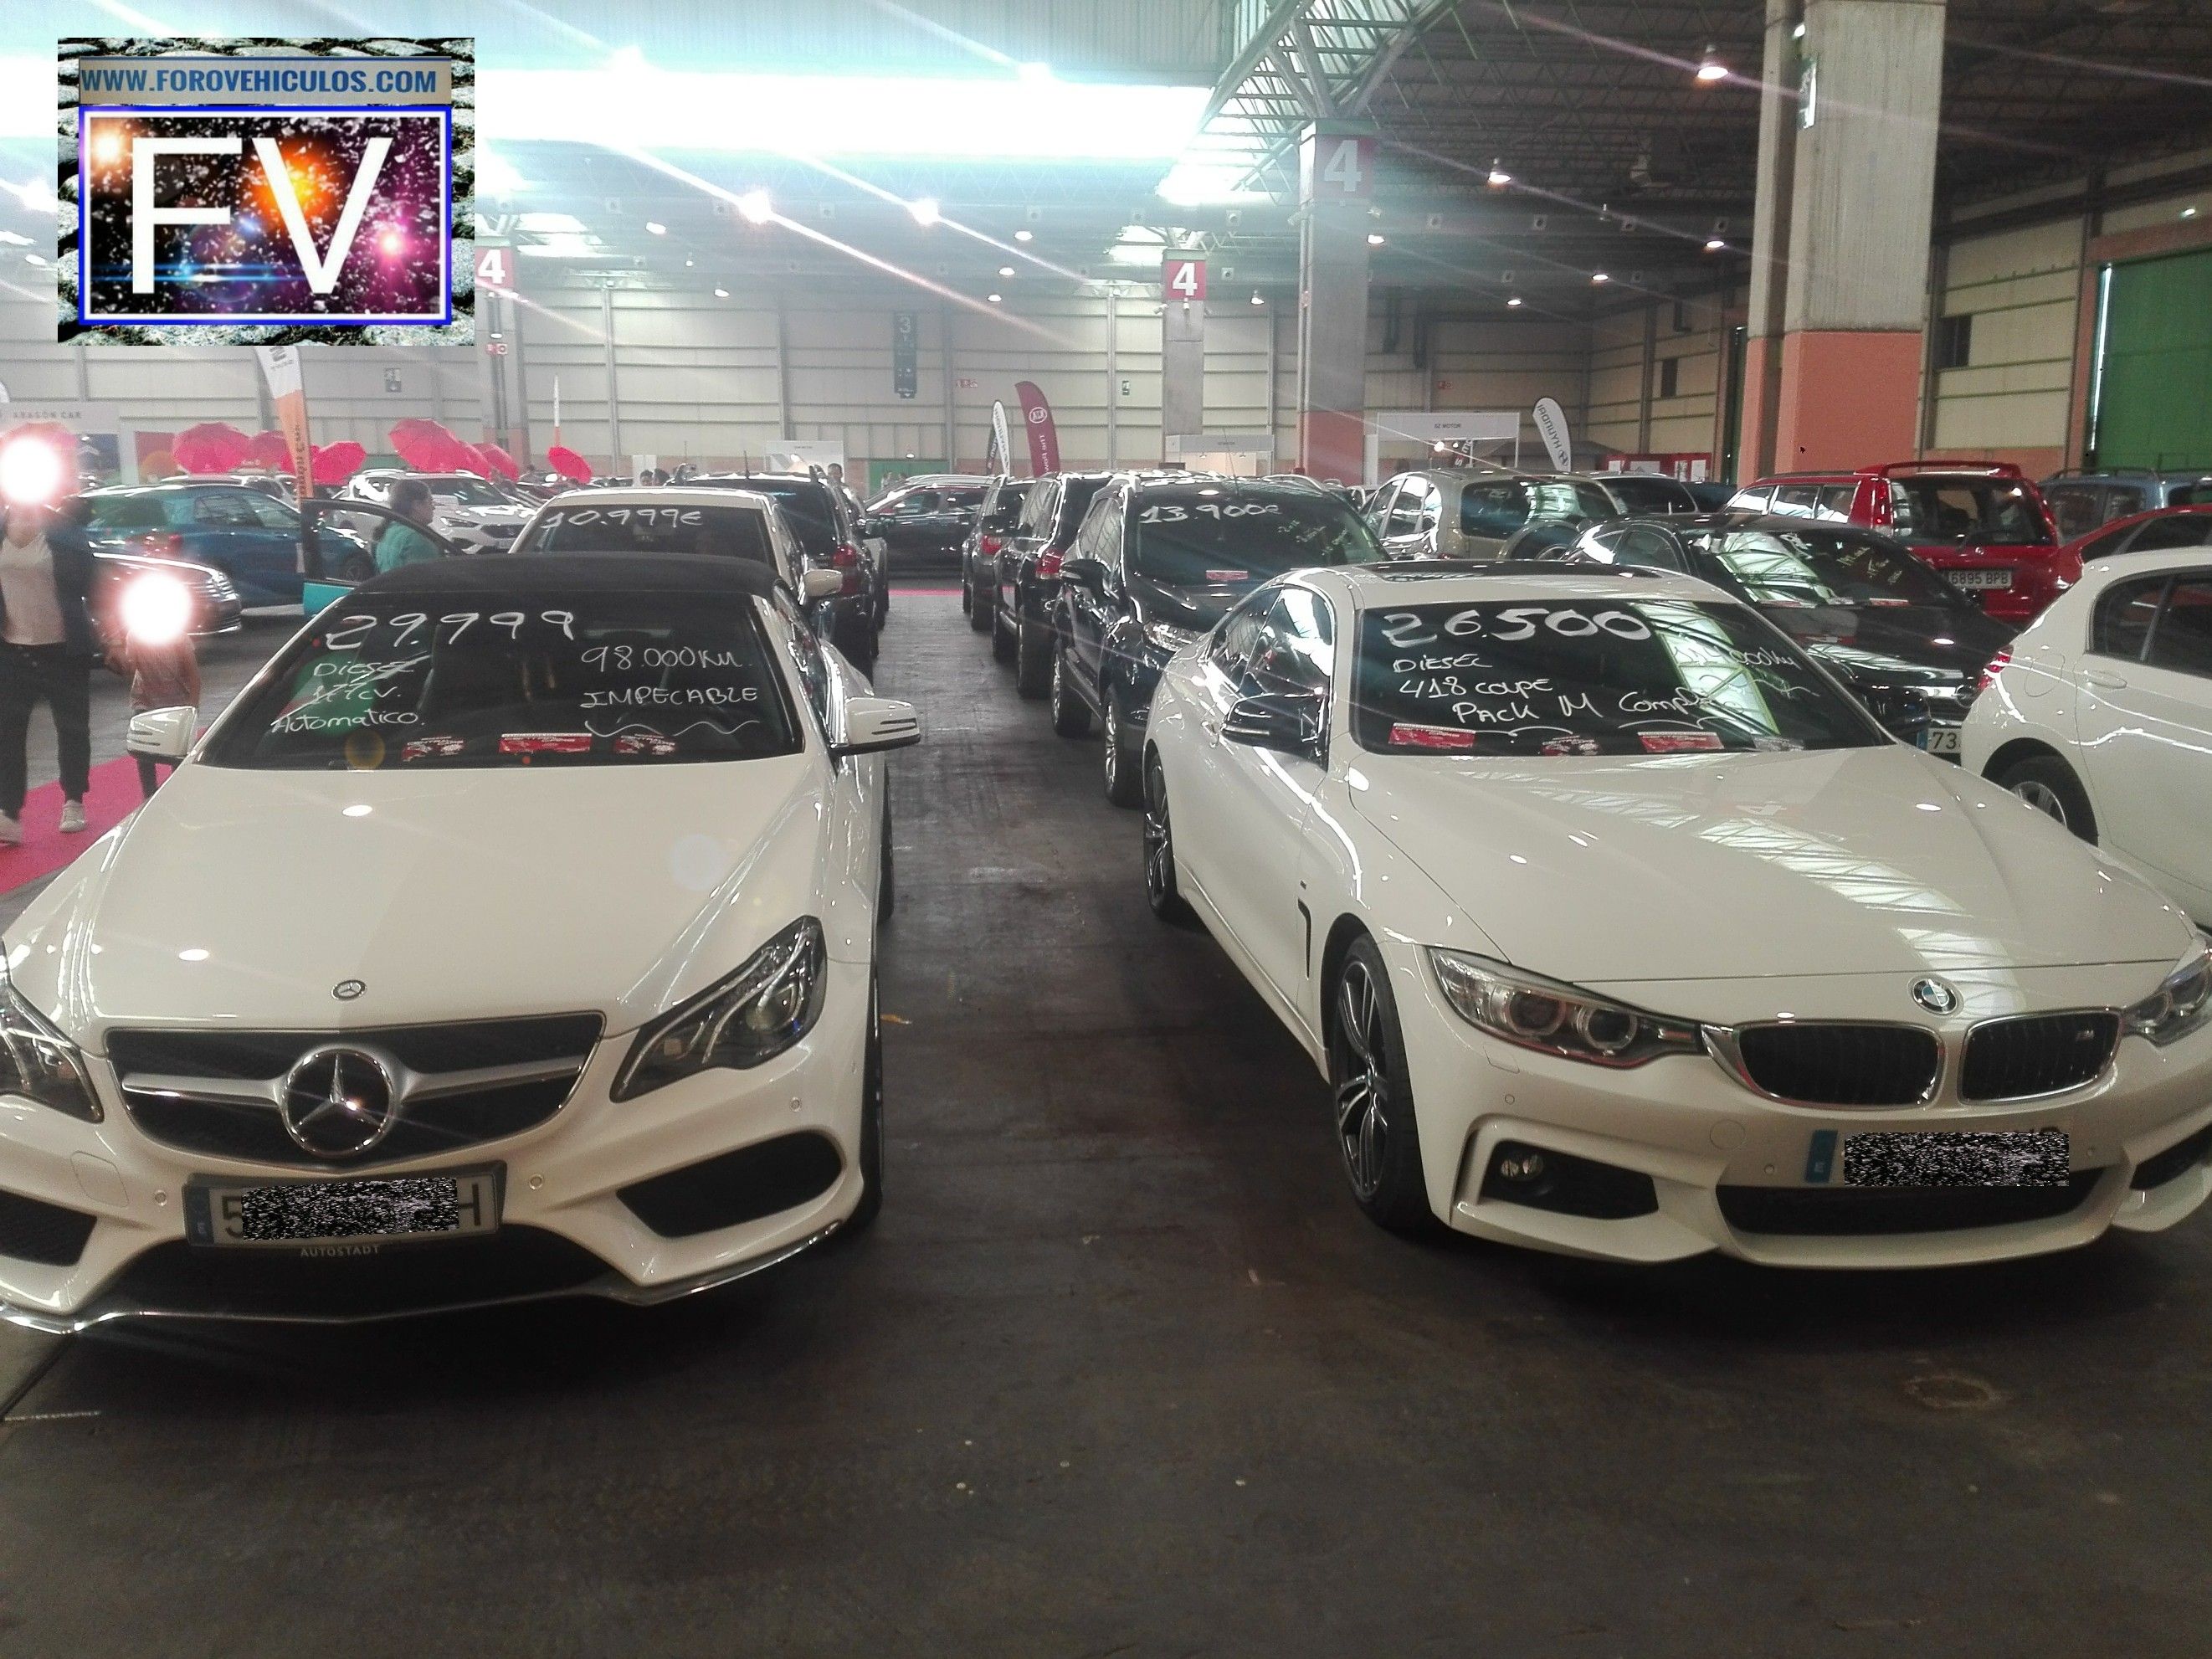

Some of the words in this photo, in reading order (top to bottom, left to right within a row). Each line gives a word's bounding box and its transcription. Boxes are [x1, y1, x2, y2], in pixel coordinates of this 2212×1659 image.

[1324, 140, 1362, 192] 4
[478, 249, 506, 284] 4
[1173, 262, 1198, 296] 4
[1951, 572, 1982, 584] 6895
[1381, 608, 1652, 648] 26.500
[580, 686, 758, 708] IMPECABLE
[1399, 676, 1466, 698] 418
[1932, 732, 1960, 750] 73
[301, 1245, 379, 1257] AUTOSTADT
